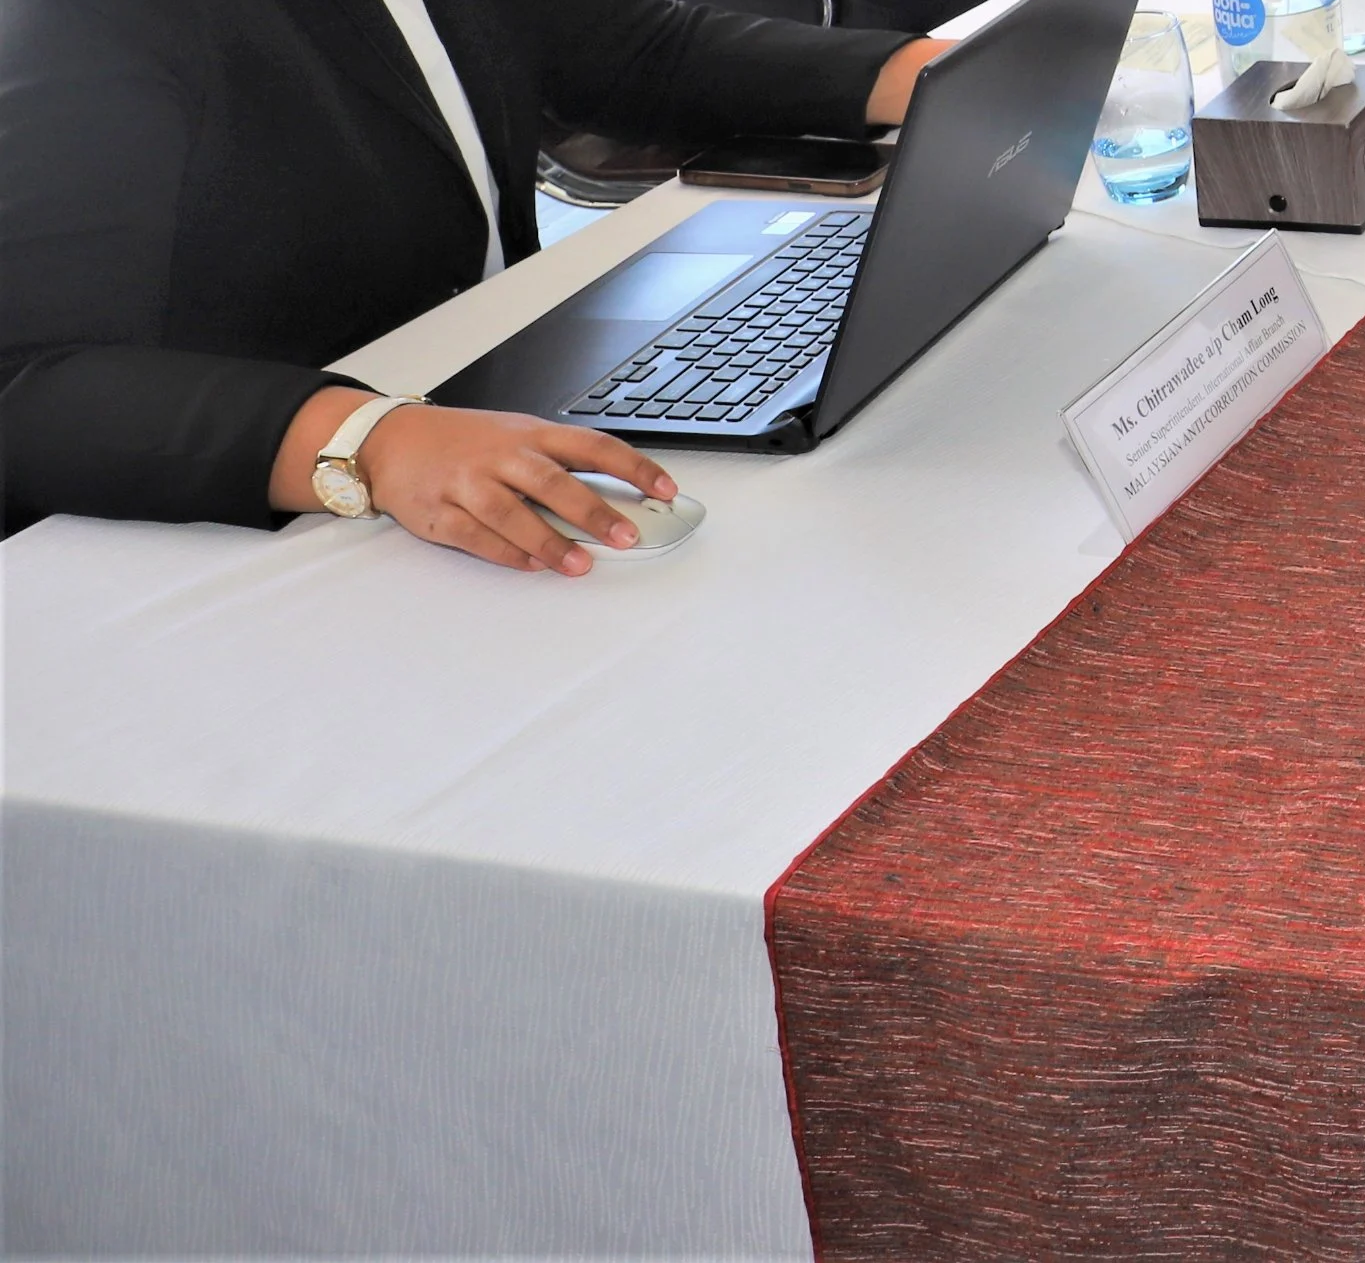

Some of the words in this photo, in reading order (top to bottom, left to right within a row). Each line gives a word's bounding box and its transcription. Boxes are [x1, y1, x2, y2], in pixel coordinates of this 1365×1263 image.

[1214, 11, 1255, 31] aqua
[1110, 411, 1138, 440] Ms.
[1134, 355, 1206, 419] Chitrawadee
[1204, 336, 1225, 360] a/p
[1220, 309, 1253, 343] Cham
[1250, 286, 1279, 316] Long
[1123, 437, 1183, 501] MALAYSIAN
[1180, 366, 1259, 447] ANTI-CORRUPTION
[1256, 319, 1307, 374] COMMISSION
[1126, 439, 1153, 465] Senior
[1203, 351, 1245, 395] International
[1261, 313, 1284, 341] Branch
